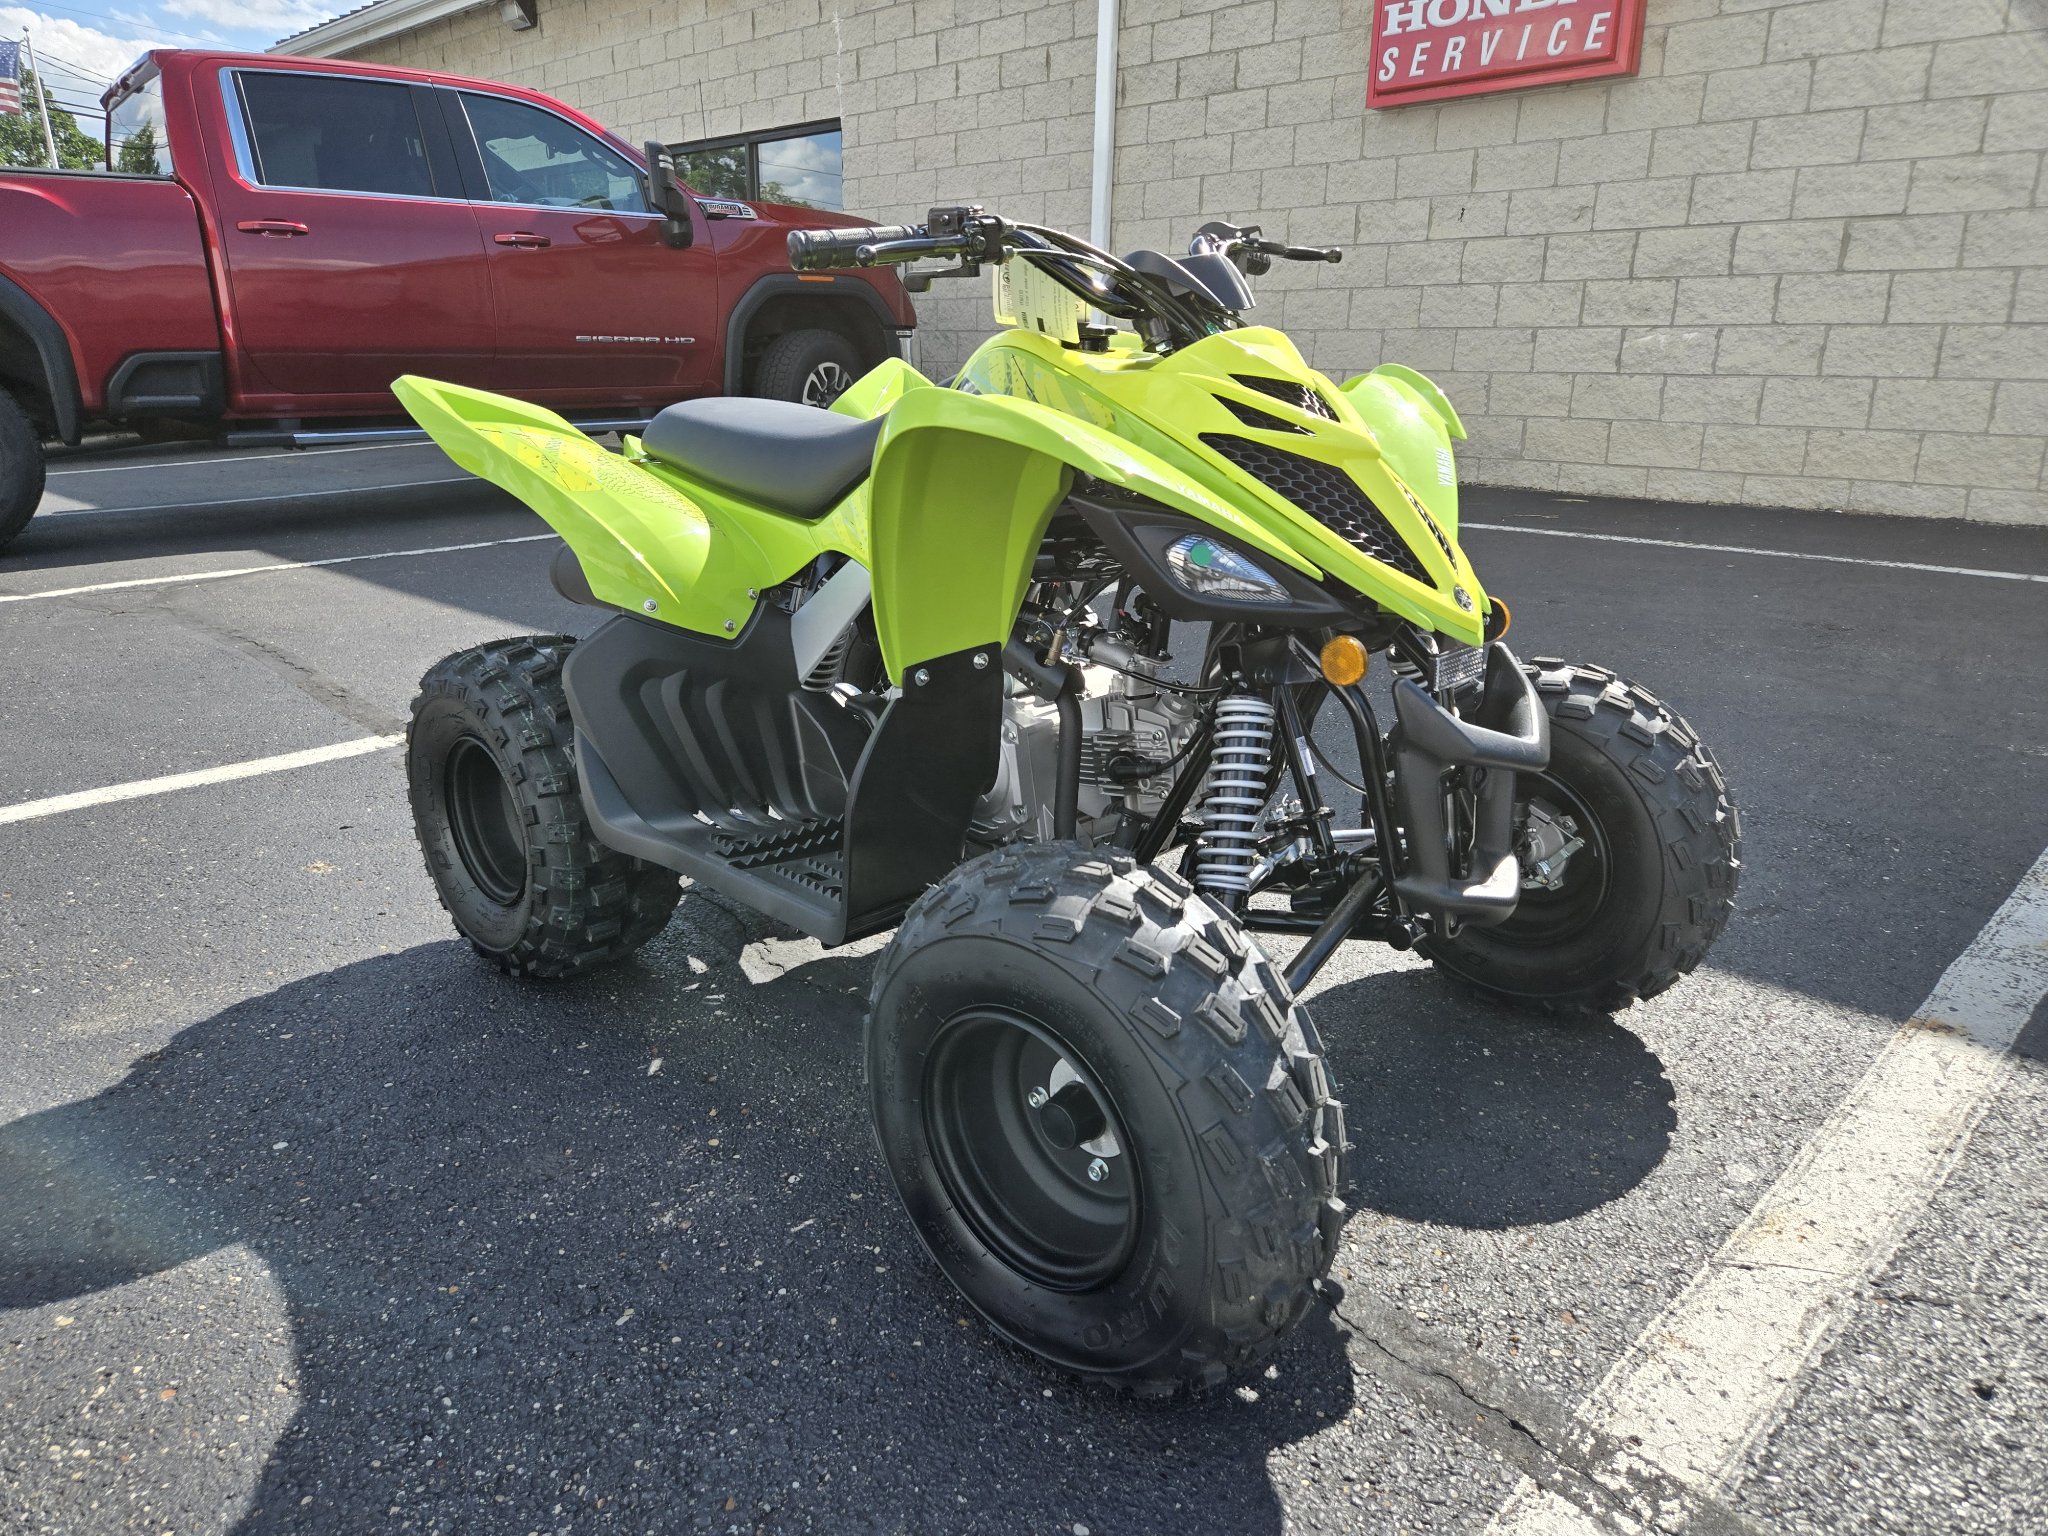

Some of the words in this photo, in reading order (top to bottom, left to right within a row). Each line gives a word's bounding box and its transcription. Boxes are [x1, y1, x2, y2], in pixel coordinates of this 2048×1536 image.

[1382, 0, 1577, 36] HON
[1378, 11, 1612, 82] SERVICE
[575, 335, 660, 343] SIERRA
[664, 336, 696, 344] HD
[1435, 447, 1453, 486] YAMAHA
[1176, 482, 1244, 525] YAMAHA
